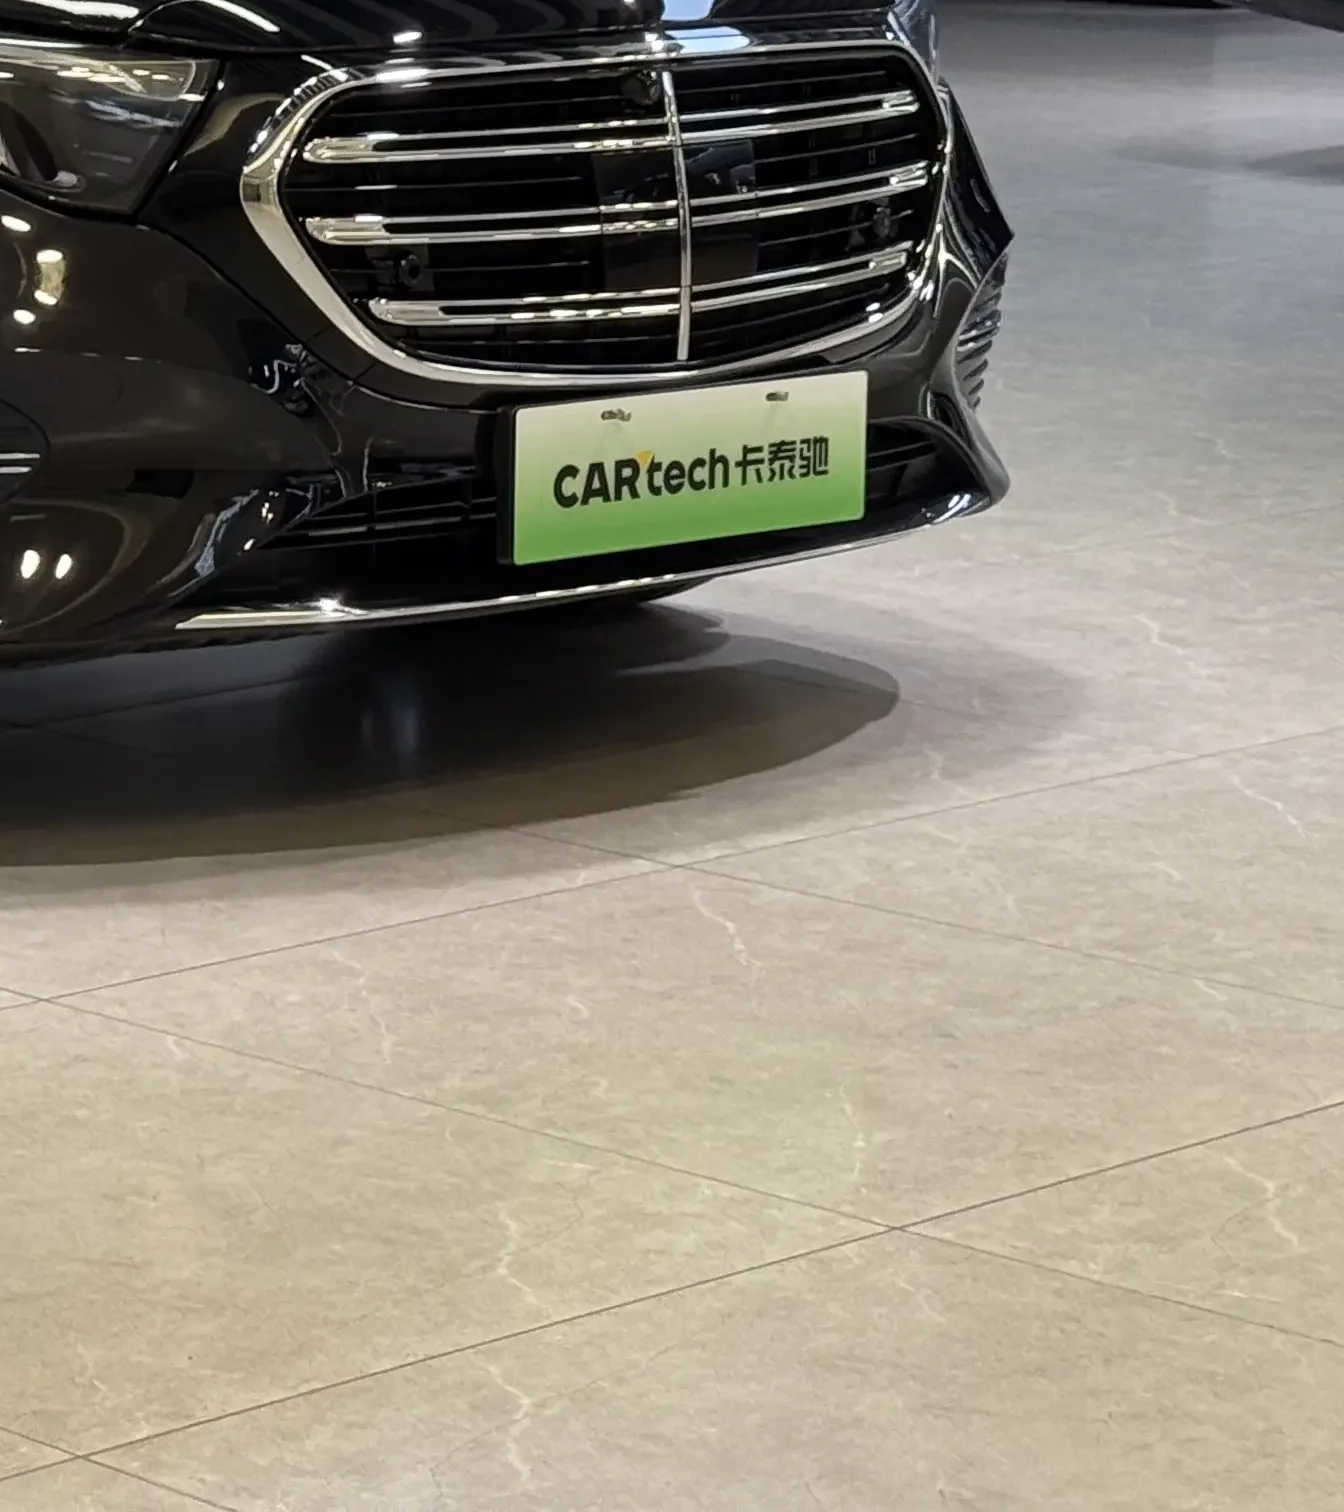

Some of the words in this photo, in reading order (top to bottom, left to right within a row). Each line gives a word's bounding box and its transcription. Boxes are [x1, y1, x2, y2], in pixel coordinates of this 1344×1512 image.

[552, 448, 730, 509] CARtech
[734, 435, 830, 487] 卡泰驰
